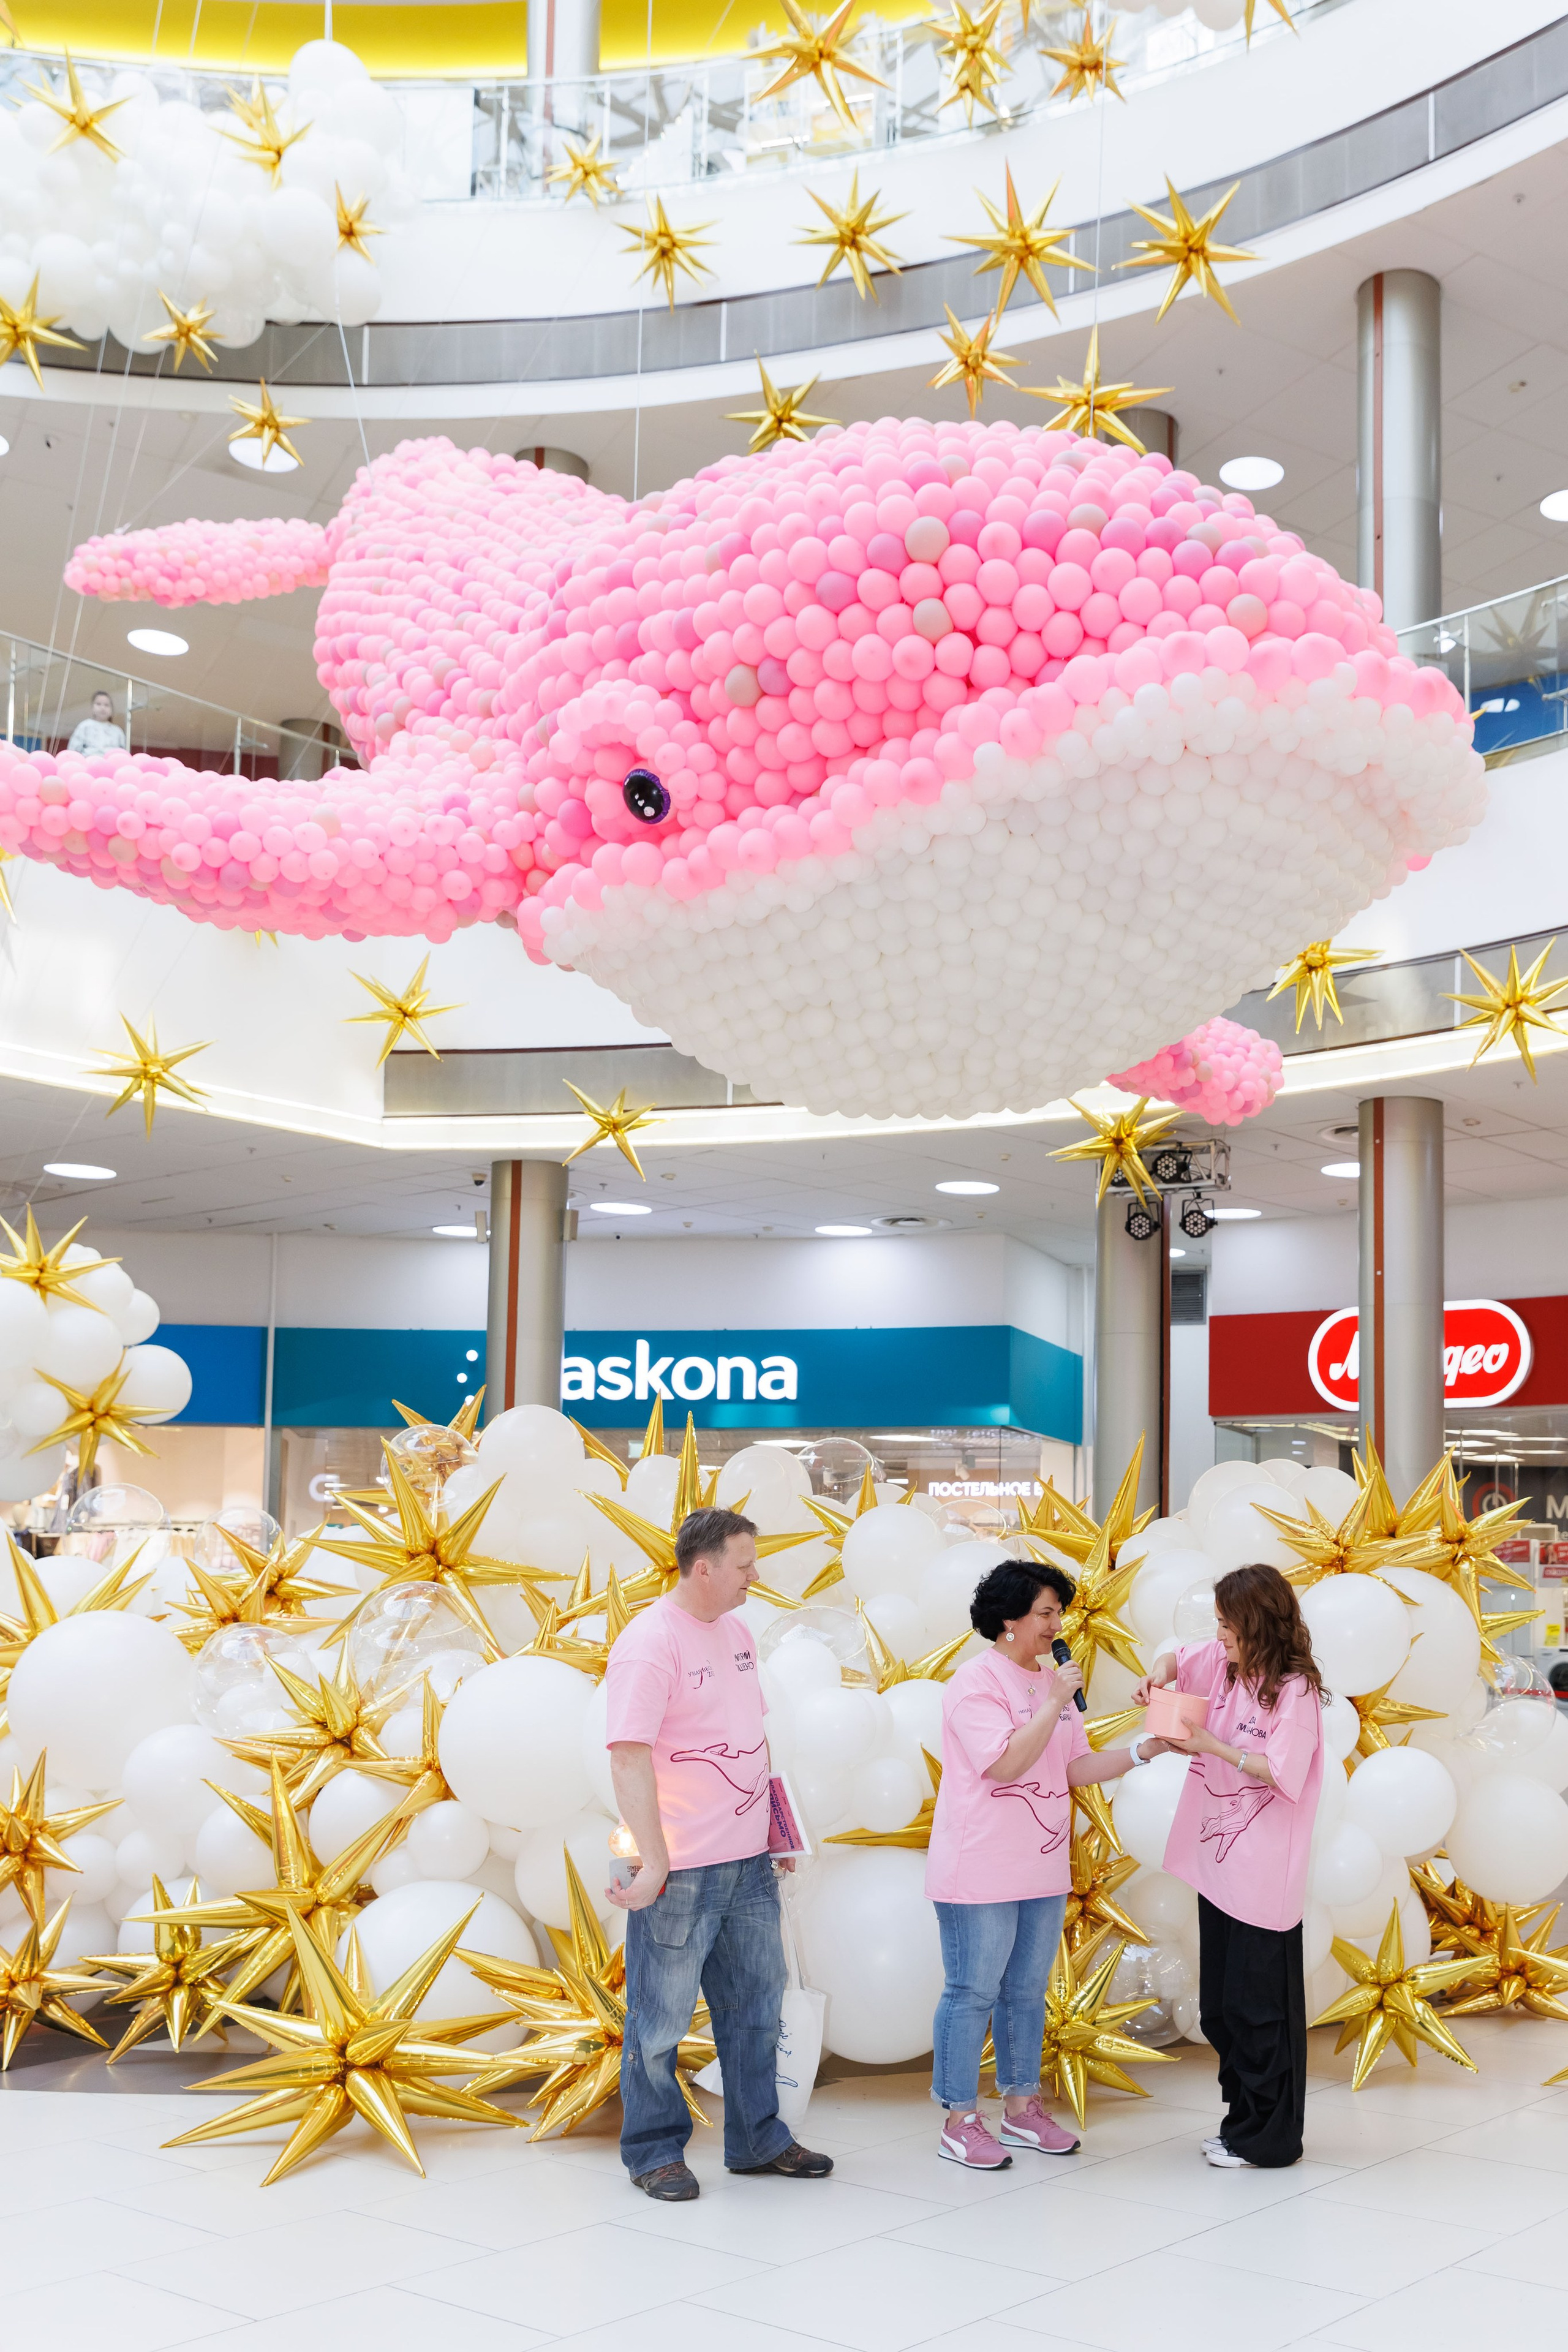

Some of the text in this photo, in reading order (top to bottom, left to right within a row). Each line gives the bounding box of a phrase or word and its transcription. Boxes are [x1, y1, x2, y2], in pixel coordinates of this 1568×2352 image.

[561, 1339, 797, 1401] askona
[929, 1482, 1031, 1496] ПОСТЕЛЬНОЕ
[769, 1792, 786, 1838] ПИСЬМО
